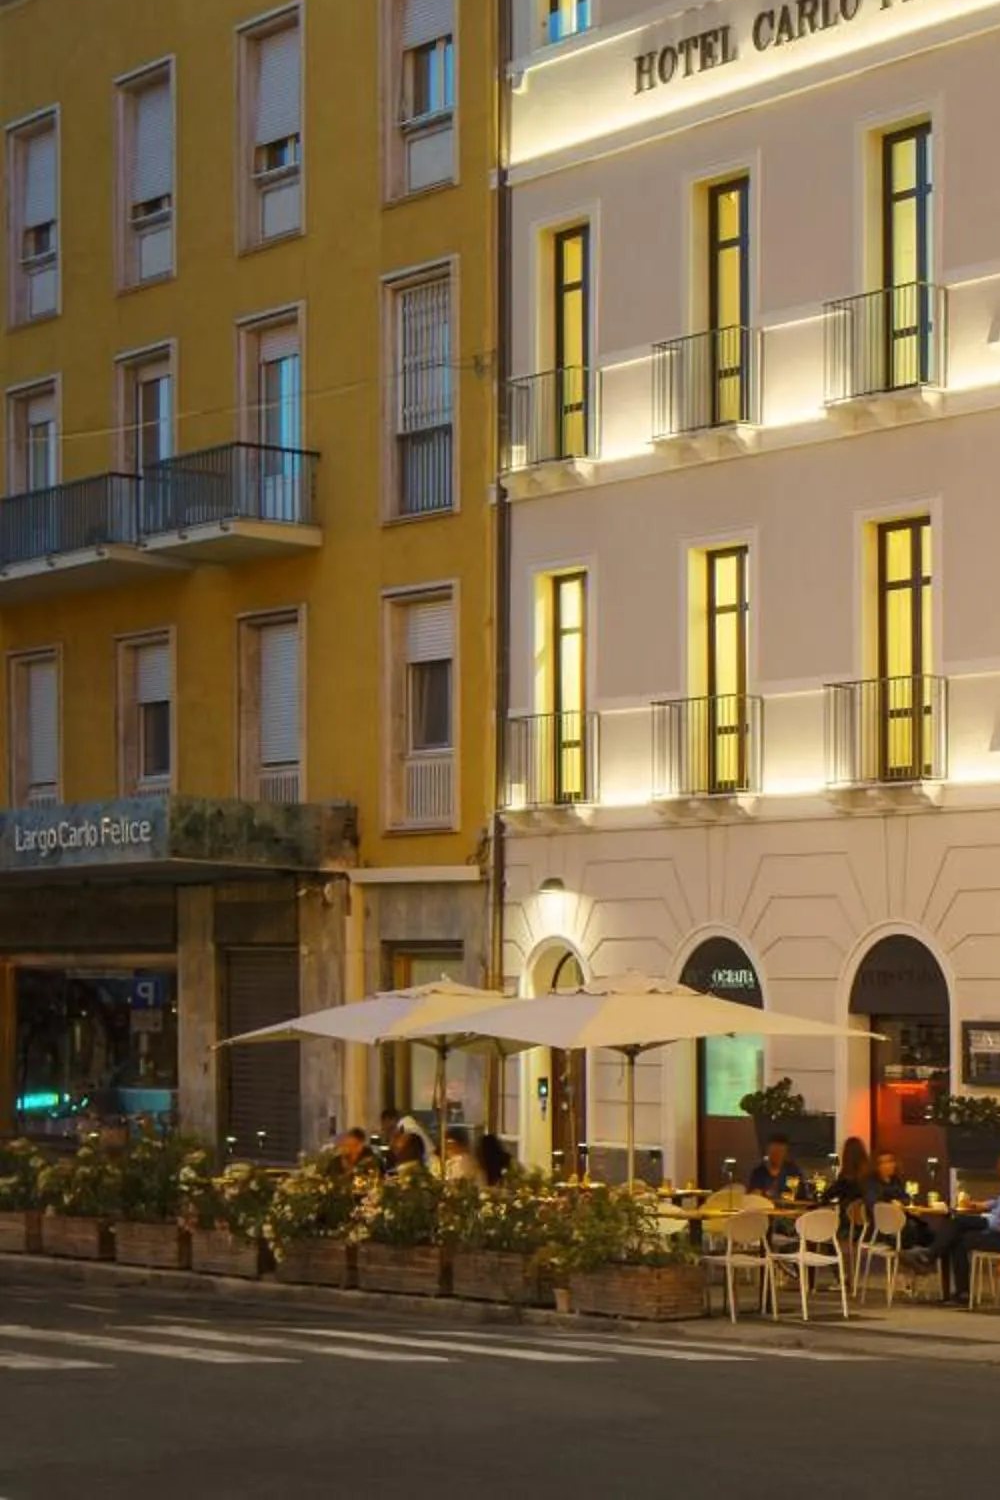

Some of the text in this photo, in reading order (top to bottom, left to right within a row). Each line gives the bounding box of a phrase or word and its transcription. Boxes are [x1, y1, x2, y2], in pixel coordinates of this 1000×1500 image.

[633, 25, 737, 94] HOTEL
[15, 816, 152, 857] Largo Carlo Felice
